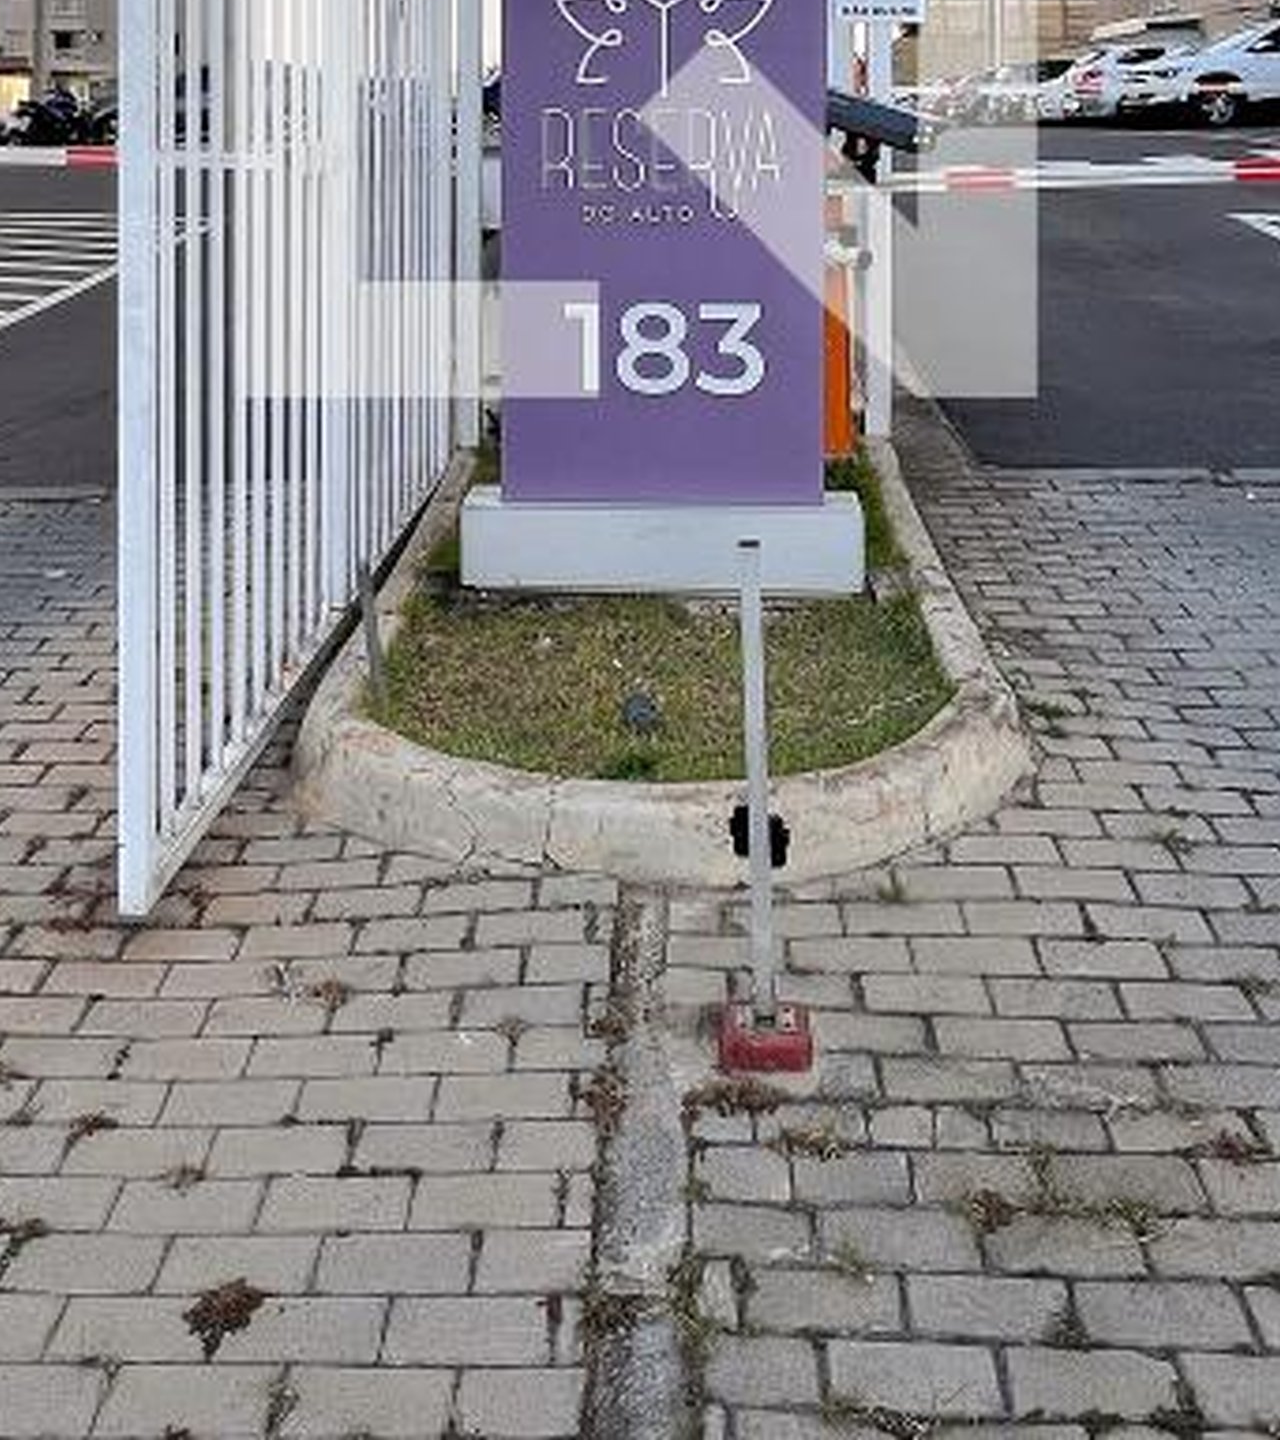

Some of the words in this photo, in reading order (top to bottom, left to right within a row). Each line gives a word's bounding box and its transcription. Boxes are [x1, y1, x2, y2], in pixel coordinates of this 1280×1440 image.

[540, 107, 781, 219] RESERVA
[628, 204, 694, 223] ALTO
[563, 301, 766, 396] 183
